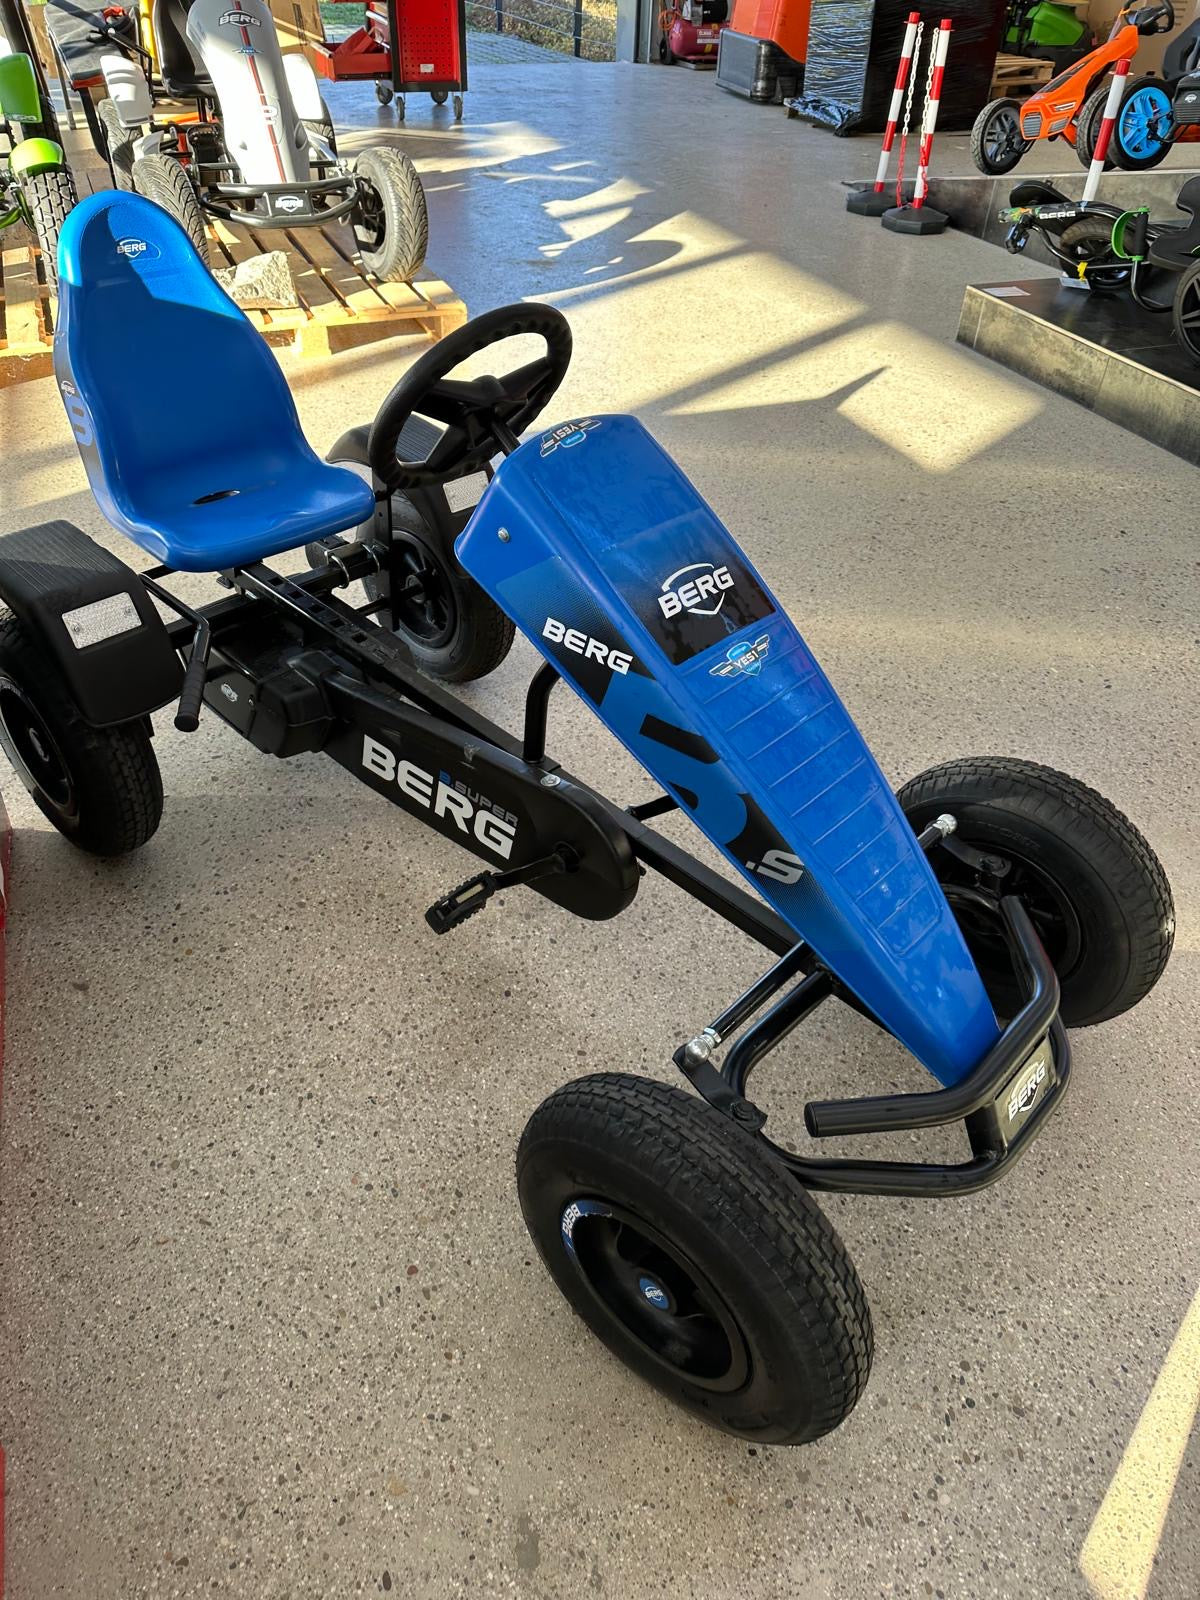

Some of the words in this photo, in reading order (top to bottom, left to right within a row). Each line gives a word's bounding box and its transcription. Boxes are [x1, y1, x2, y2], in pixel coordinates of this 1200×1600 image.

[219, 14, 261, 27] BERG
[1039, 210, 1076, 220] BERG
[116, 242, 147, 254] BERG
[657, 566, 735, 619] BERG
[542, 617, 633, 675] BERG
[733, 649, 759, 669] YES1
[362, 733, 517, 860] BERG
[439, 769, 519, 828] B.SUPER
[1008, 1060, 1046, 1121] BERG
[562, 1203, 581, 1238] BERG
